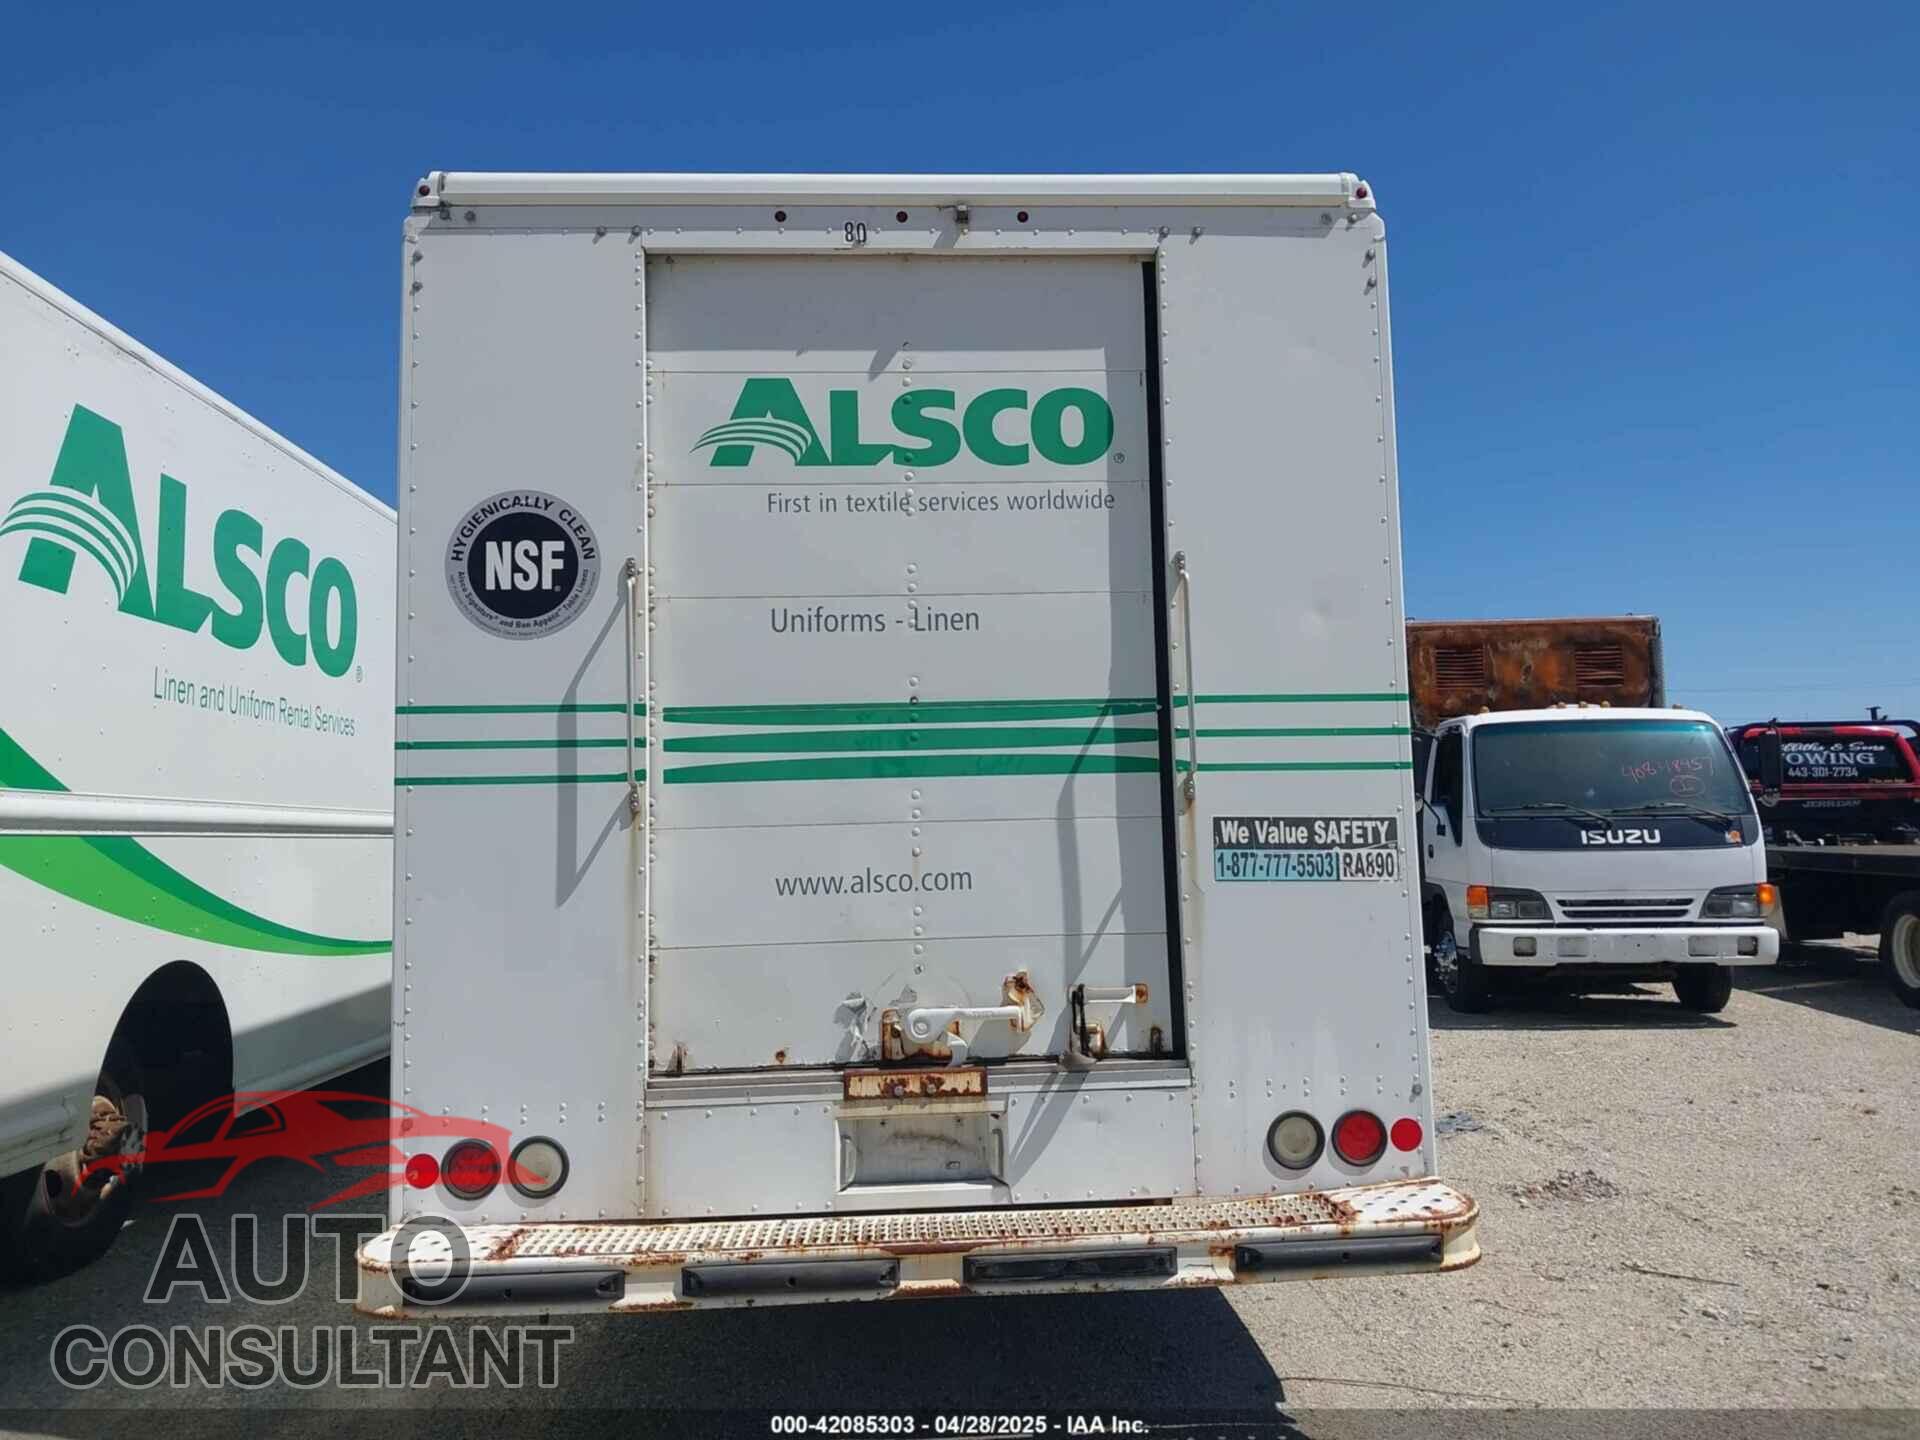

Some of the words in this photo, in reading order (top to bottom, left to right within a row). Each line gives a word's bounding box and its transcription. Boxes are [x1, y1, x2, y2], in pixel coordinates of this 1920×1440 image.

[844, 222, 867, 243] 80
[689, 378, 1114, 467] ALSCO
[768, 492, 810, 513] First
[819, 492, 837, 513] in
[847, 491, 911, 513] textile
[919, 491, 999, 511] services
[1006, 488, 1116, 511] worldwide
[0, 403, 358, 678] ALSCO
[451, 496, 554, 561] HYGIENICALLY
[558, 509, 595, 560] CLEAN
[485, 540, 565, 591] NSF
[771, 606, 886, 632] Uniforms
[913, 606, 979, 631] Linen
[154, 666, 195, 705] Linen
[200, 683, 225, 712] and
[230, 685, 276, 722] Uniform
[279, 697, 312, 729] Rental
[314, 705, 356, 737] Services
[1782, 751, 1876, 765] OWING
[1830, 743, 1843, 752] &
[1220, 820, 1249, 844] We
[1255, 820, 1309, 844] Value
[1314, 820, 1390, 844] SAFETY
[1581, 829, 1661, 844] ISUZU
[1217, 853, 1334, 878] 1-877-777-5503
[1343, 853, 1395, 878] RA890
[775, 867, 972, 896] www.alsco.com
